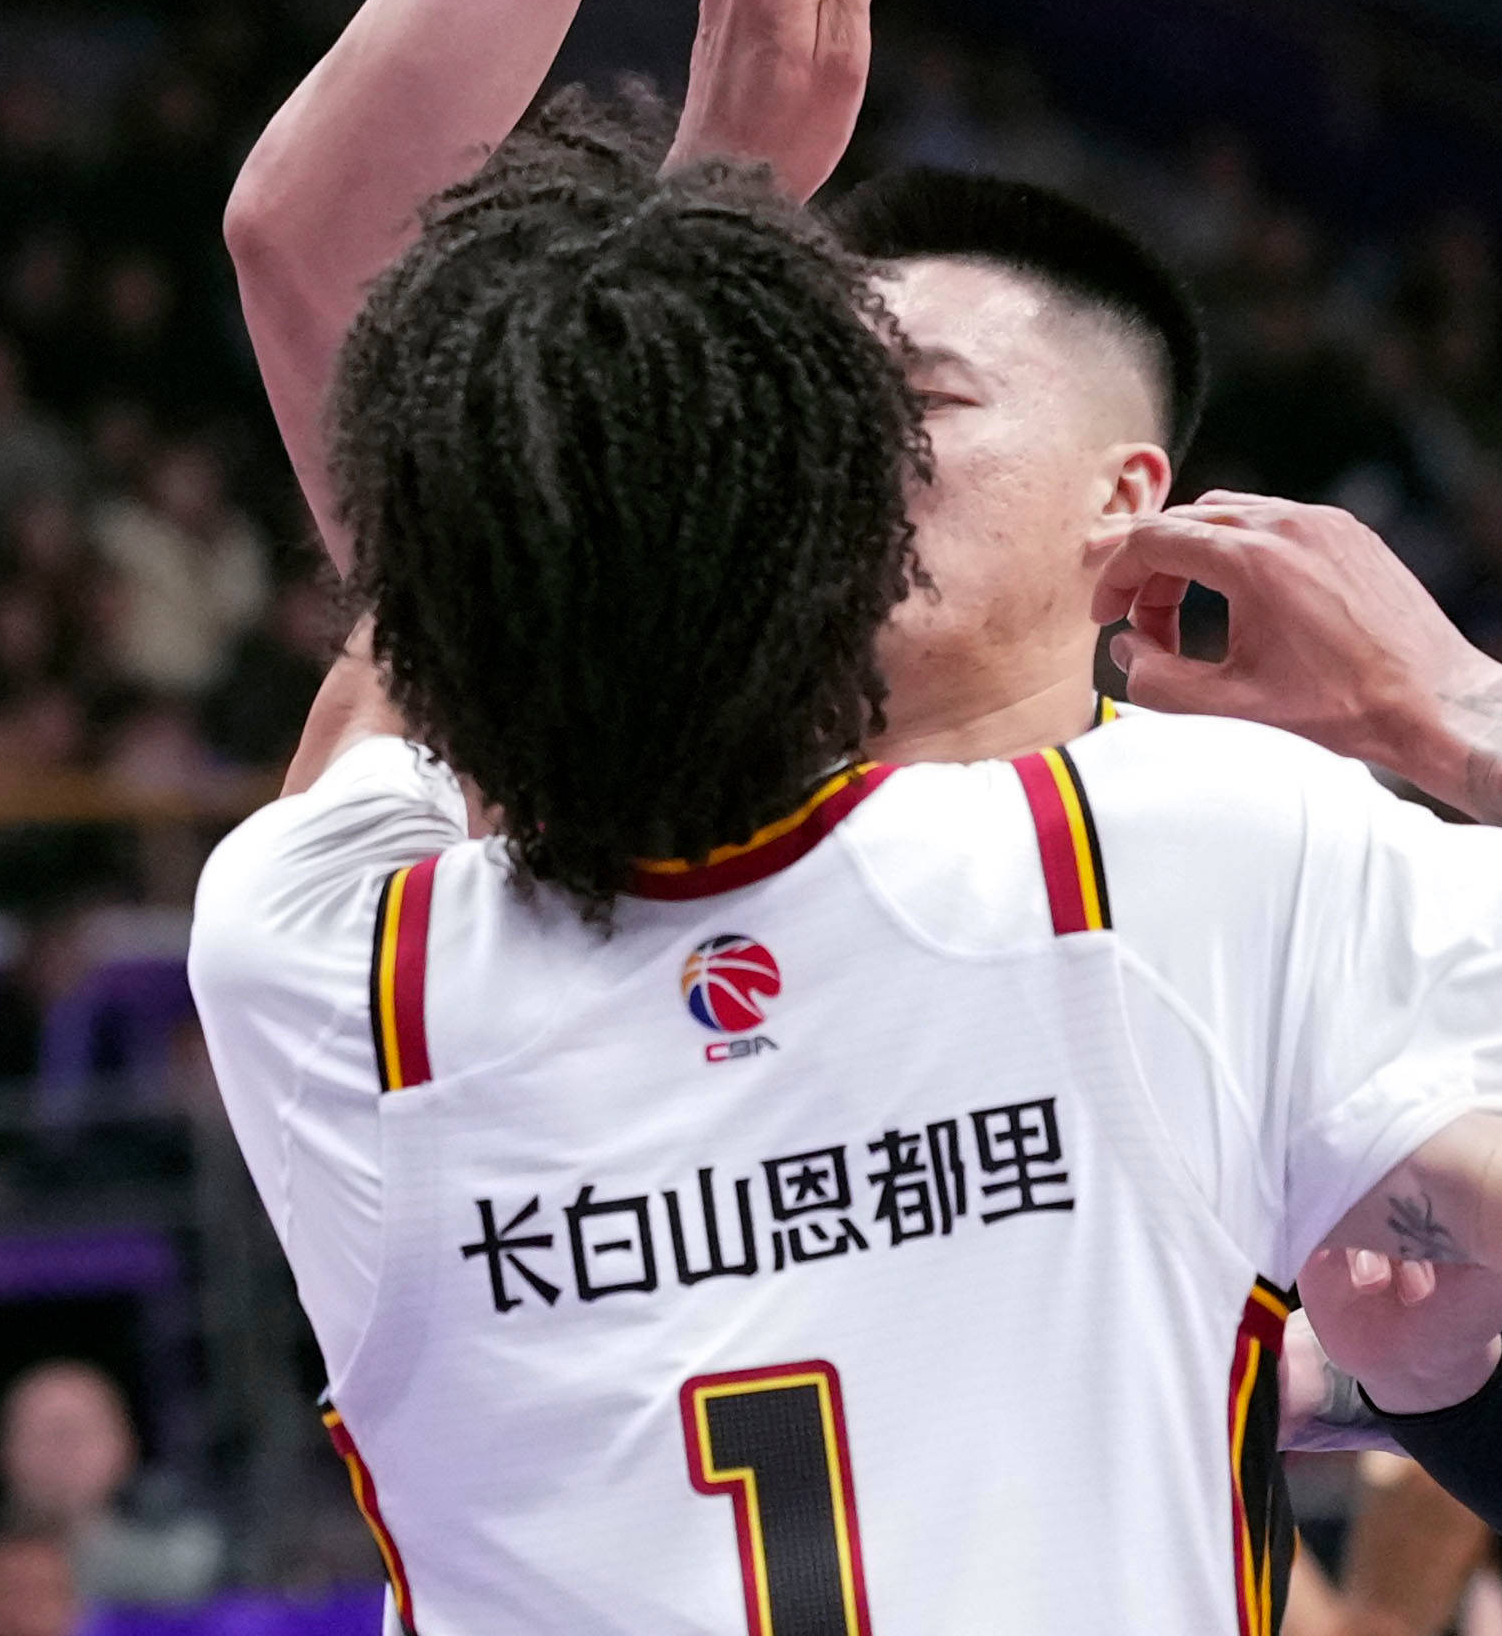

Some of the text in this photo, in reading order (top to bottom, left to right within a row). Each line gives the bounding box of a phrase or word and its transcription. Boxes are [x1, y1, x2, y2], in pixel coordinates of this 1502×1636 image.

[705, 1036, 780, 1063] CBA
[461, 1097, 1075, 1314] 长白山恩都里
[679, 1359, 873, 1636] 1
